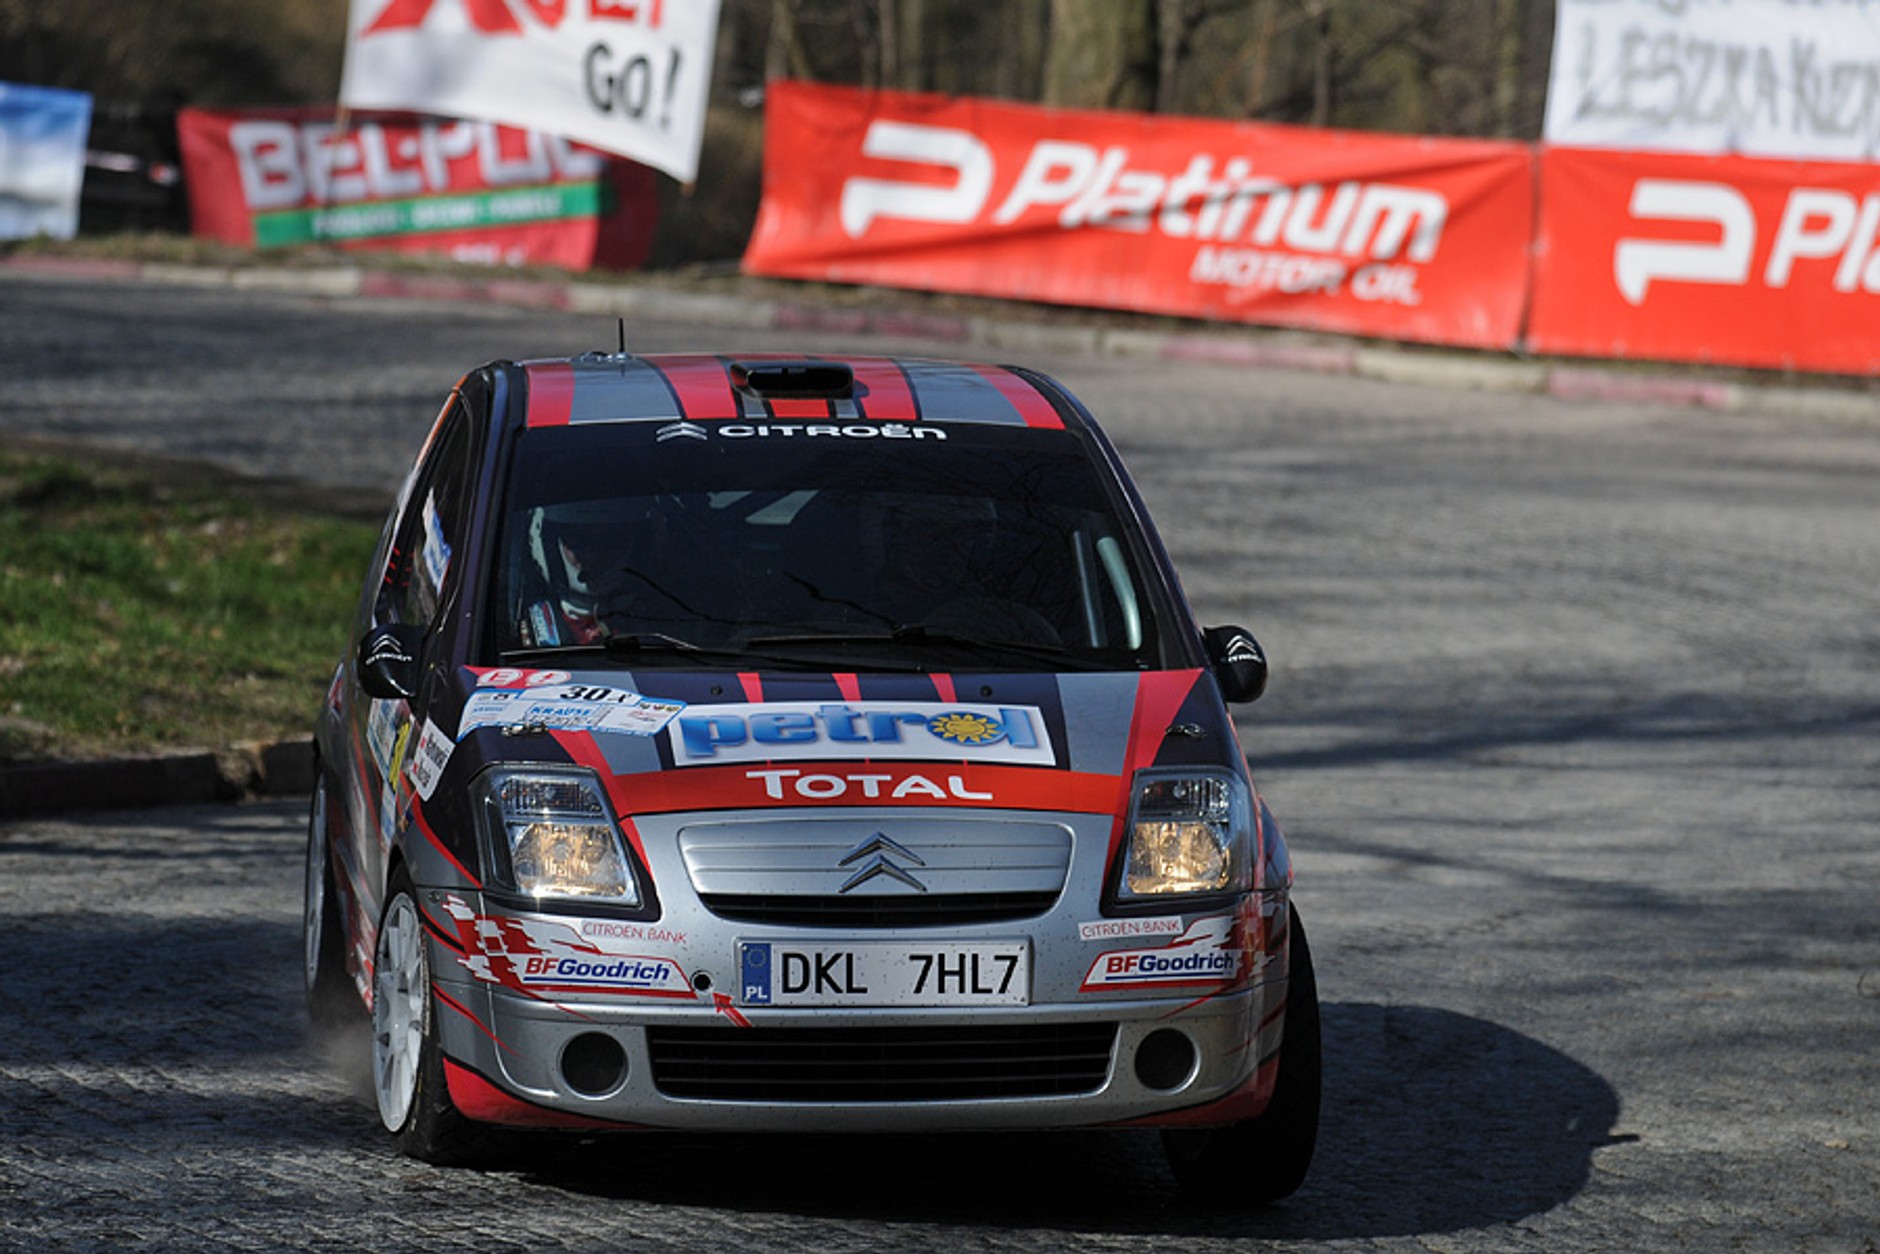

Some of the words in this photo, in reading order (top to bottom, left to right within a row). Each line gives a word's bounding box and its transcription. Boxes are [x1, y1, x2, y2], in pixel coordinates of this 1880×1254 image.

[583, 40, 683, 130] GO!
[992, 138, 1450, 262] Platinum
[1191, 245, 1347, 296] MOTOR
[1351, 262, 1423, 305] OIL
[682, 703, 1039, 758] petrol
[746, 769, 993, 802] TOTAL
[648, 927, 687, 944] BANK
[1143, 919, 1181, 934] BANK
[525, 956, 670, 981] BFGoodrich
[781, 952, 868, 995] DKL
[909, 952, 1019, 995] 7HL7
[1106, 952, 1234, 974] BFGoodrich
[745, 986, 768, 1000] PL
